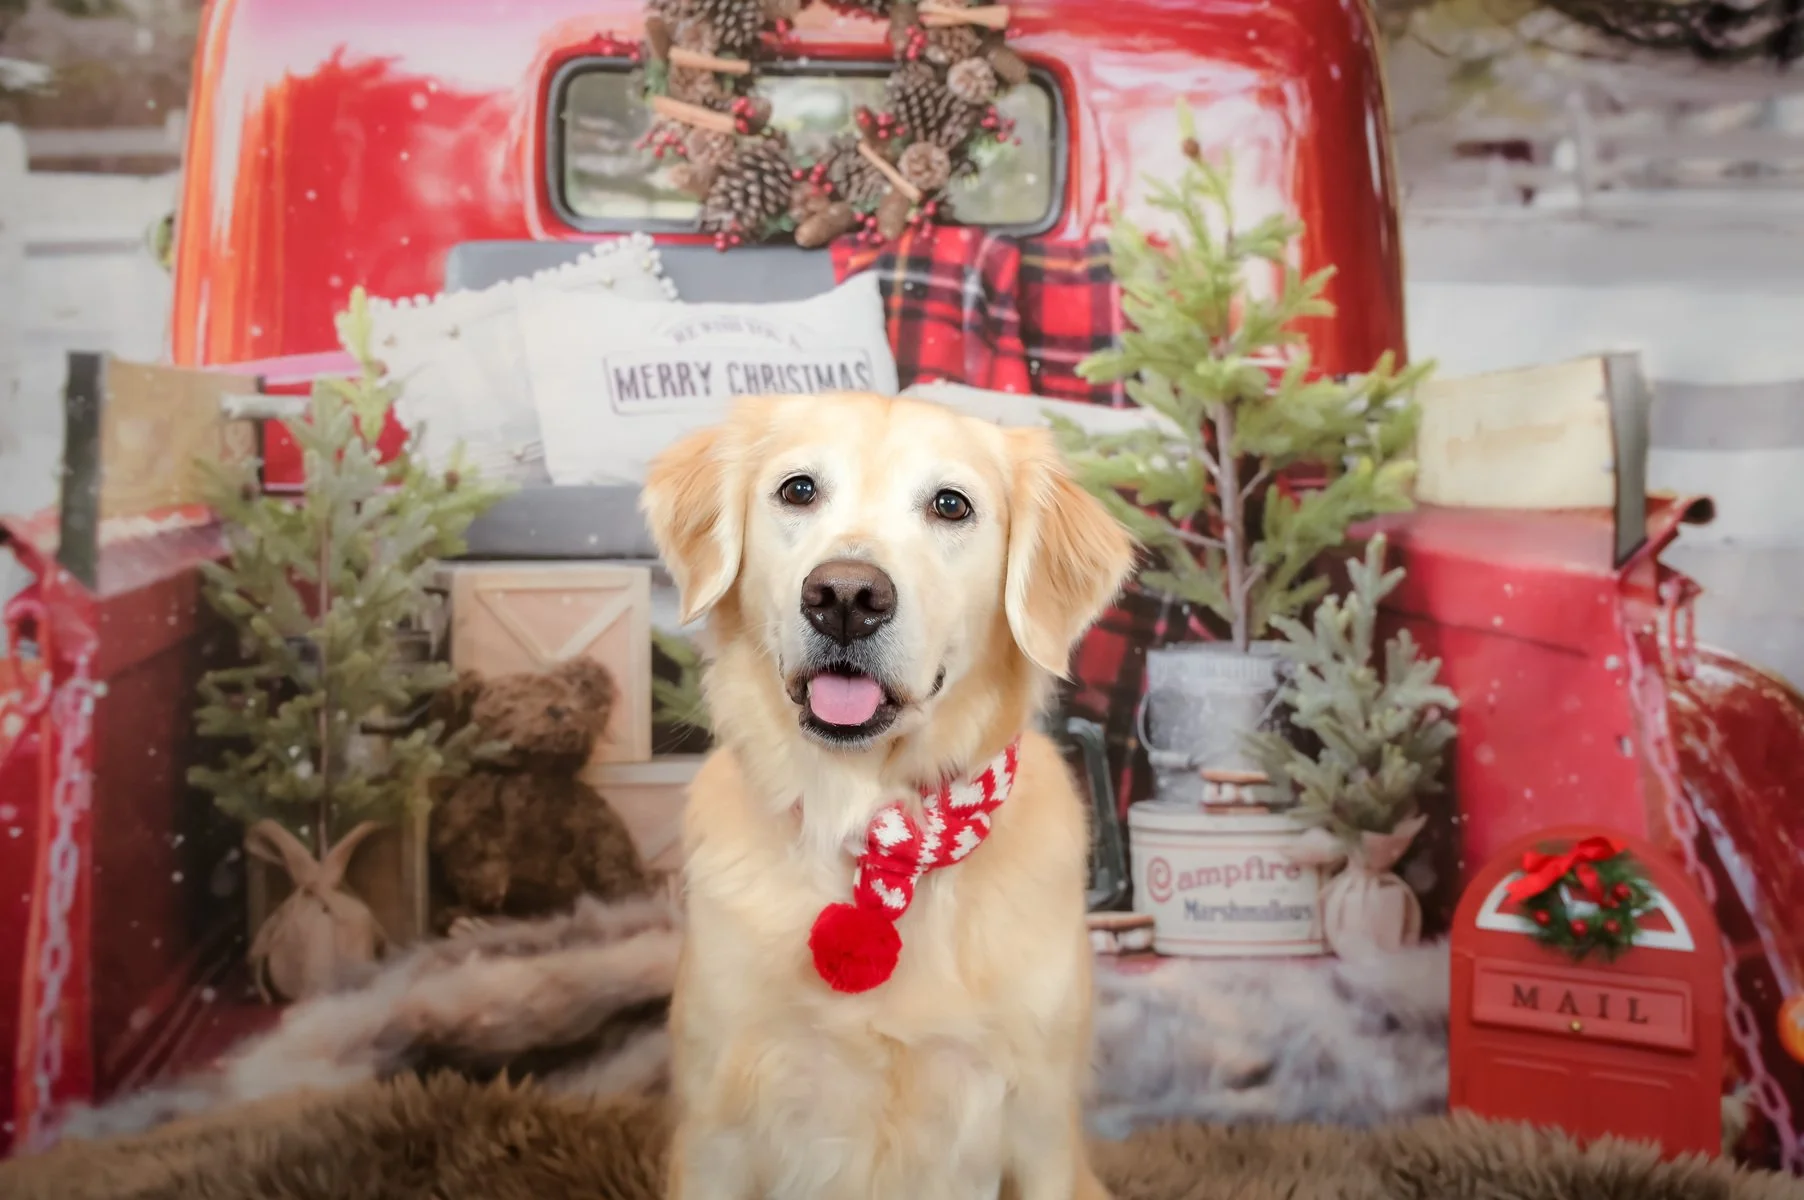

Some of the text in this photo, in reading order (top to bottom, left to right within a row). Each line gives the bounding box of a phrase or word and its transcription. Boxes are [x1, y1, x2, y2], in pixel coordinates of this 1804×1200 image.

[613, 360, 871, 402] MERRY CHRISTMAS
[1147, 857, 1301, 903] Campfire
[1511, 983, 1648, 1024] MAIL
